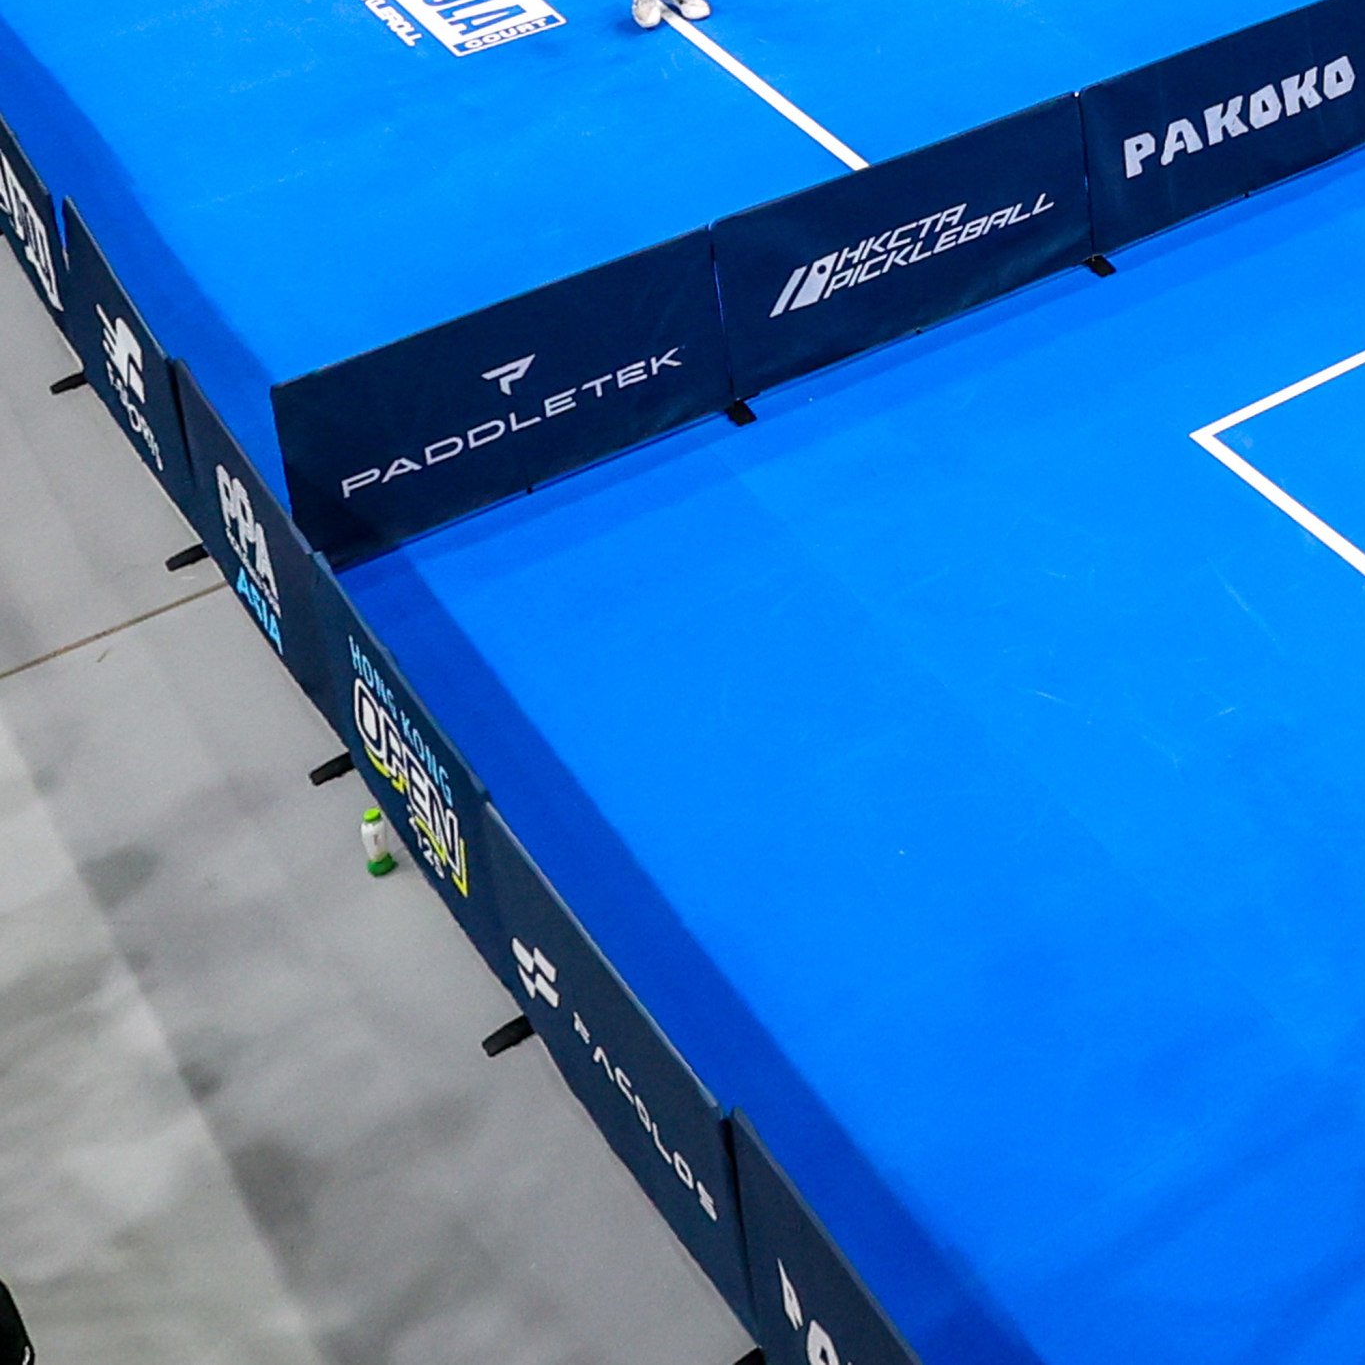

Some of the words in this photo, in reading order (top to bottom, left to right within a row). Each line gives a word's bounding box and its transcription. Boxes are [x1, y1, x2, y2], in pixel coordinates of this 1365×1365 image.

[464, 16, 548, 50] COURT
[1123, 54, 1356, 180] PAKOKO
[822, 192, 1056, 301] PICKLEBALL
[834, 202, 969, 268] HKCTA
[340, 345, 683, 500] PADDLETEK
[235, 566, 284, 656] ASIA
[349, 635, 397, 721] HONG
[400, 710, 453, 807] KONG
[354, 678, 468, 898] OPEN
[573, 1011, 717, 1222] FACOLOS
